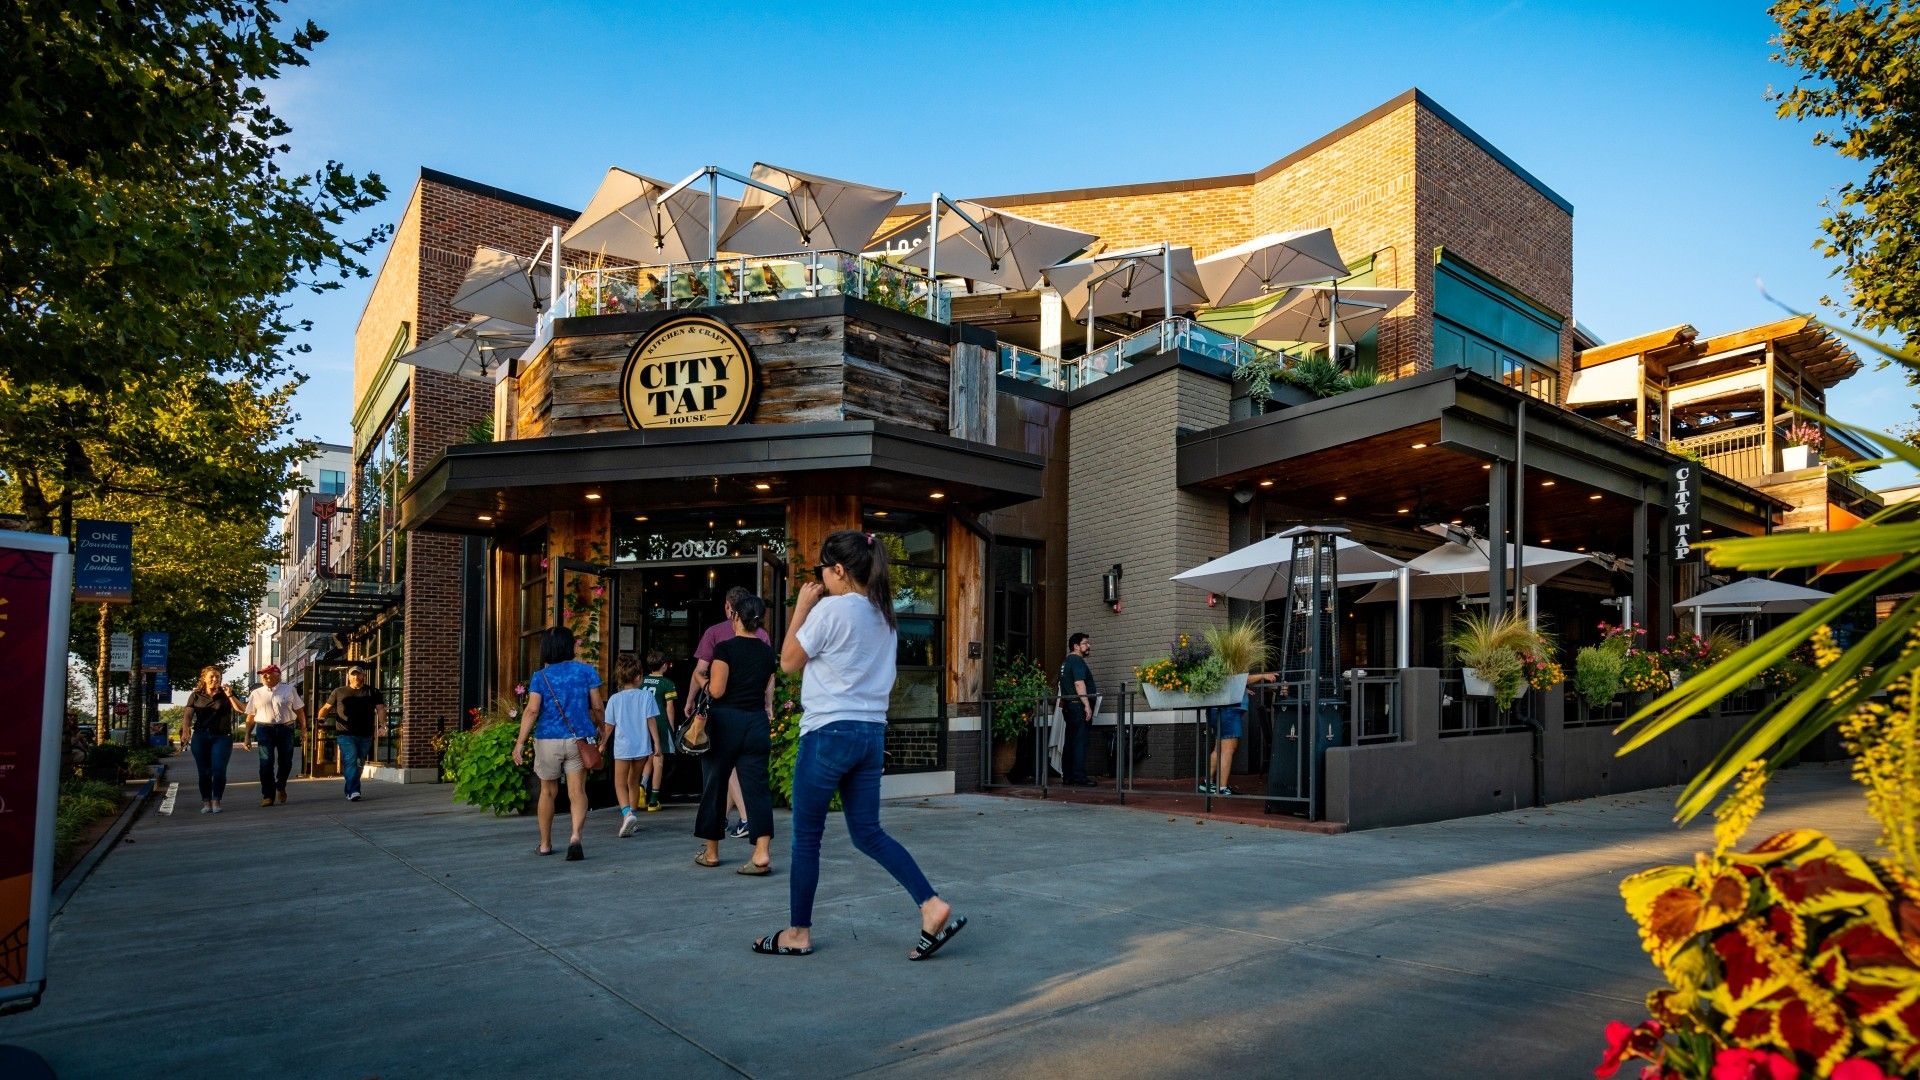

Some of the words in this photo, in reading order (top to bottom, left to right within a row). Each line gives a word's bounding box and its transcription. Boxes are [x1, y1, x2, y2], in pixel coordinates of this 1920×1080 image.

[647, 328, 685, 355] KITCHEN
[687, 326, 696, 334] &
[699, 328, 727, 345] CRAFT
[639, 354, 734, 390] CITY
[647, 384, 728, 417] TAP
[668, 414, 707, 425] HOUSE
[1675, 467, 1690, 516] CITY
[80, 539, 129, 550] Downtown
[91, 532, 118, 541] ONE
[1675, 523, 1690, 560] TAP
[671, 539, 728, 558] 20376
[84, 562, 124, 572] Loudoun
[90, 554, 117, 563] ONE
